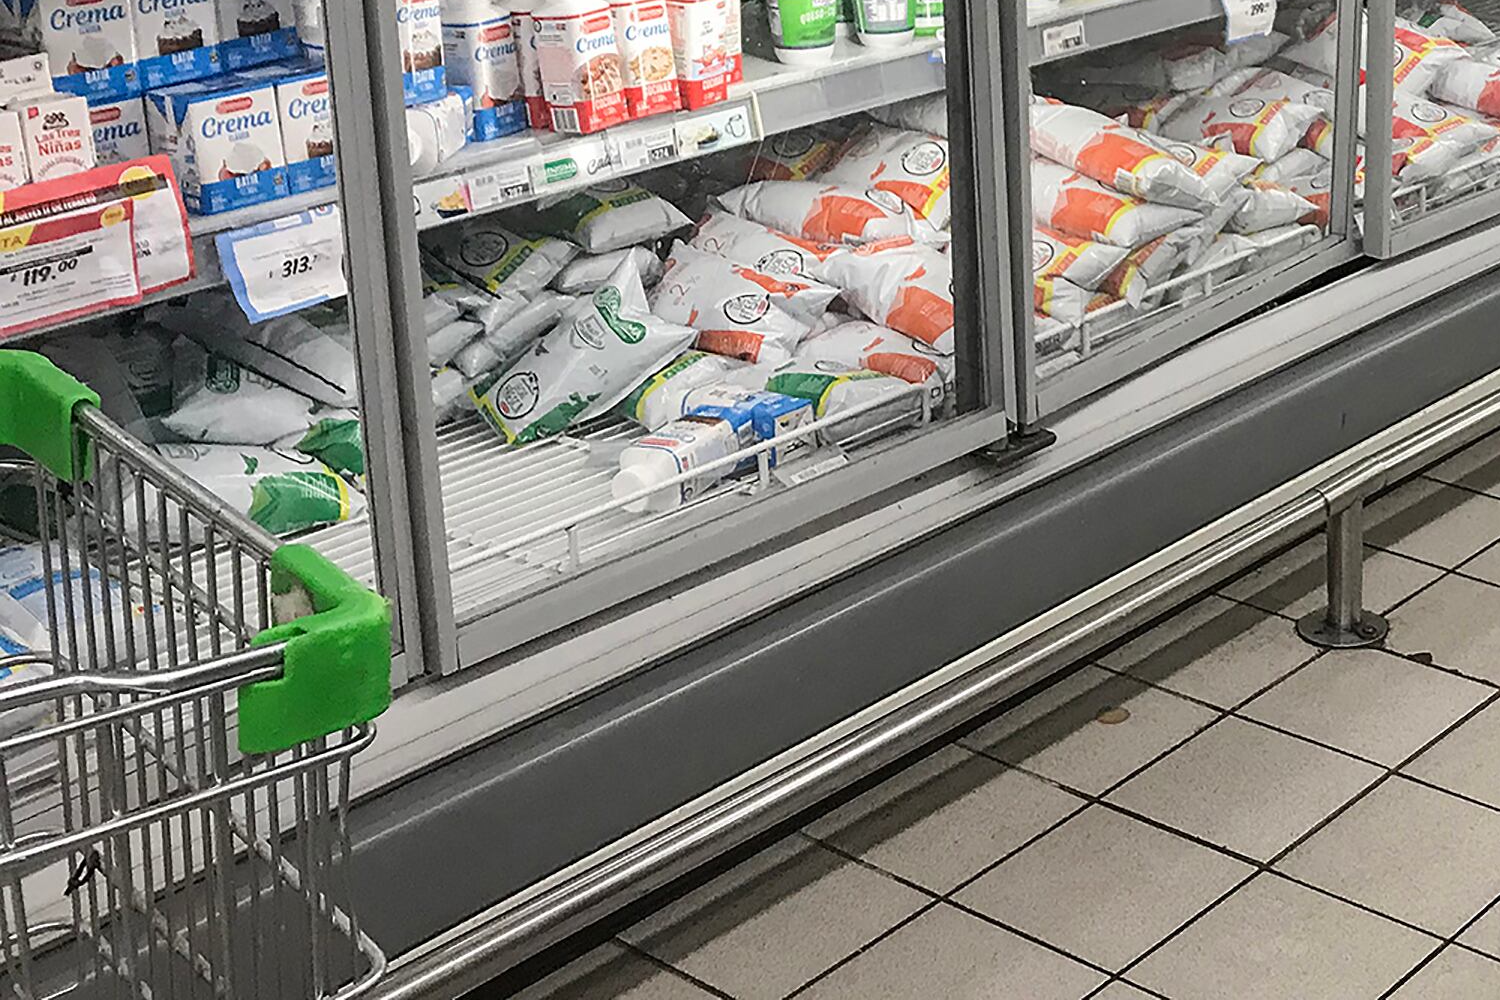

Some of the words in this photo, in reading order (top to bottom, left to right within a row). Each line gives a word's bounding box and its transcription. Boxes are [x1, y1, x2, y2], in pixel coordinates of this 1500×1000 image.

[50, 6, 127, 32] Crema
[288, 96, 331, 120] Cre
[93, 121, 142, 142] ema
[201, 108, 273, 138] Crema
[38, 138, 83, 157] Niñas
